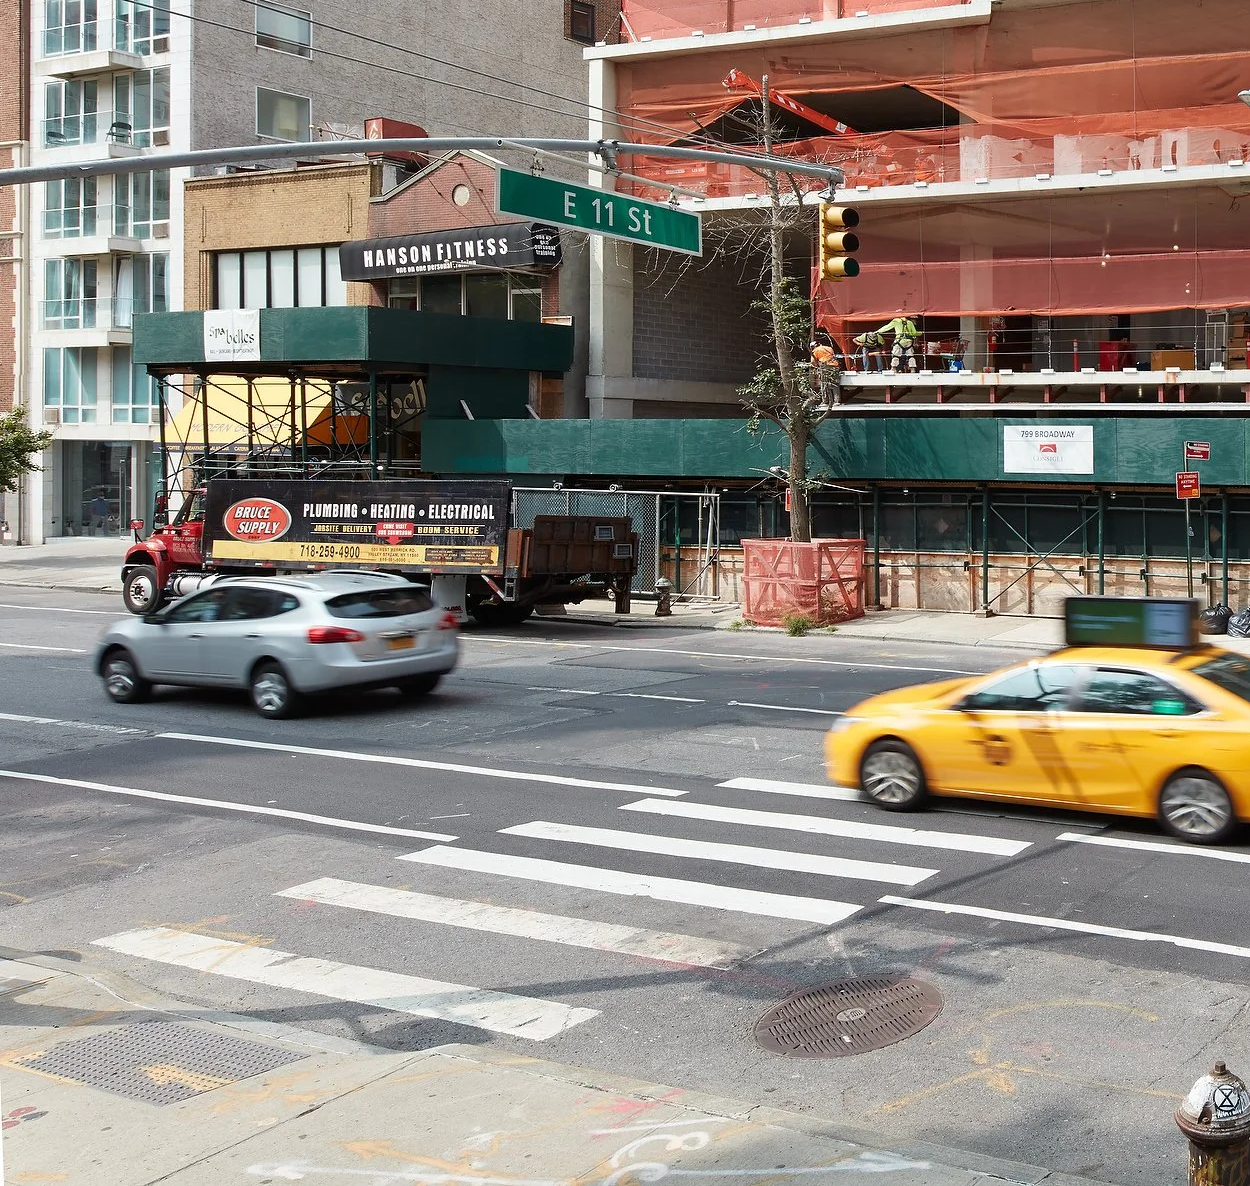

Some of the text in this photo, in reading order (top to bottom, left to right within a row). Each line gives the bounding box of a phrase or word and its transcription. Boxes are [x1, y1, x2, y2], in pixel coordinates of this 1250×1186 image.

[564, 190, 652, 235] E 11 St
[363, 237, 509, 268] HANSON FITNESS
[395, 266, 407, 274] one
[415, 264, 426, 272] one
[427, 261, 453, 271] personal
[1021, 430, 1075, 438] 799 BROADWAY
[234, 506, 272, 519] BRUCE
[303, 503, 495, 520] PLUMBING HEATING ELECTRICAL
[237, 521, 280, 534] SUPPLY
[313, 524, 373, 533] JOBSITE DELIVERY
[417, 526, 479, 535] BOOM SERVICE
[300, 545, 360, 559] 718-259-4900
